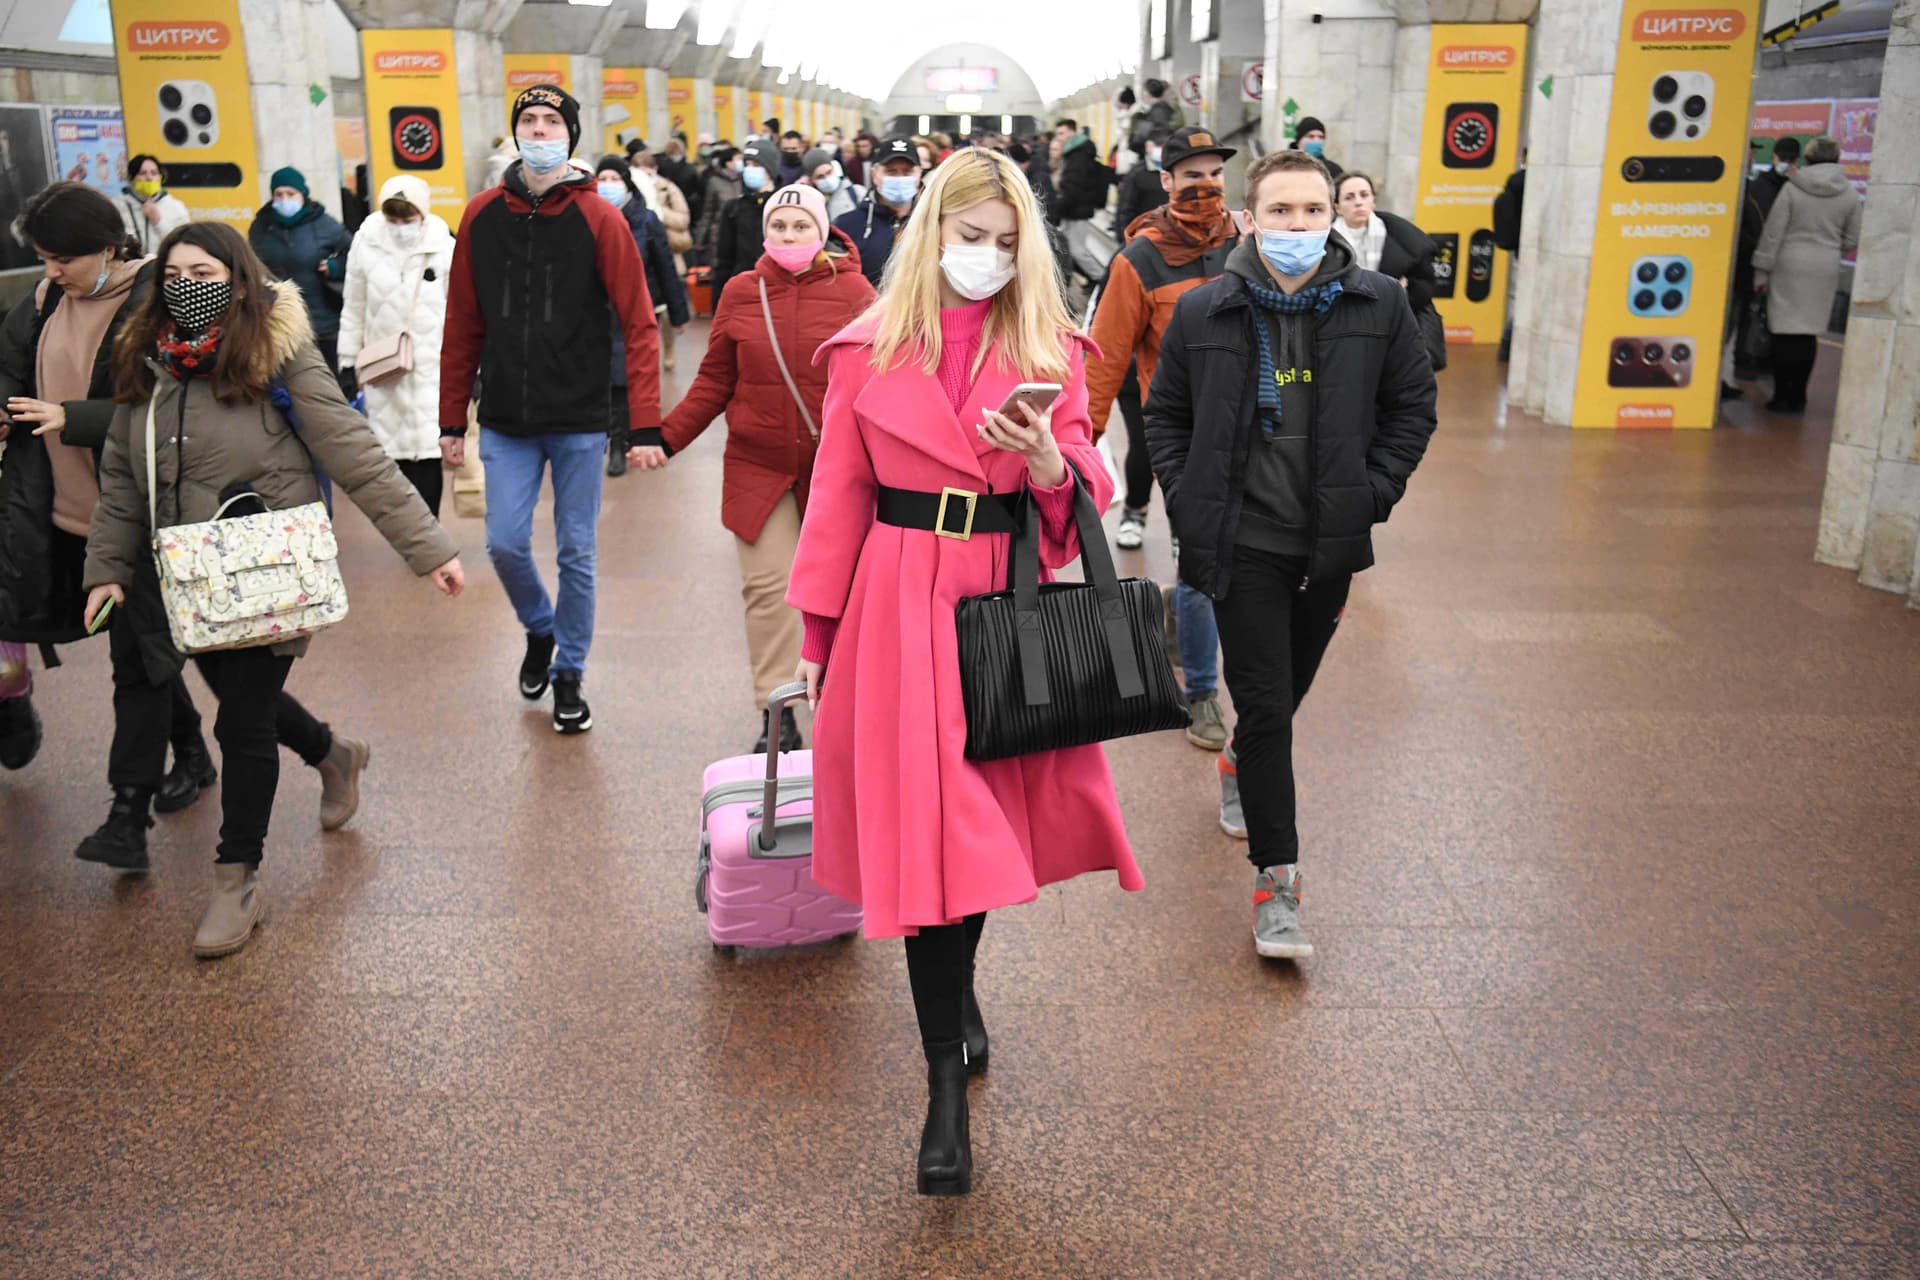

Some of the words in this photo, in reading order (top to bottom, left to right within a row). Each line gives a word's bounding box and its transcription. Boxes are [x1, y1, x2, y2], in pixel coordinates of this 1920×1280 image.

[1642, 16, 1733, 35] ЦИТРУС
[135, 26, 219, 46] ЦИТРУС
[378, 54, 440, 69] ЦИТРУС
[1444, 49, 1508, 64] ЦИТРУС
[1621, 223, 1711, 238] КАМЕРОЮ
